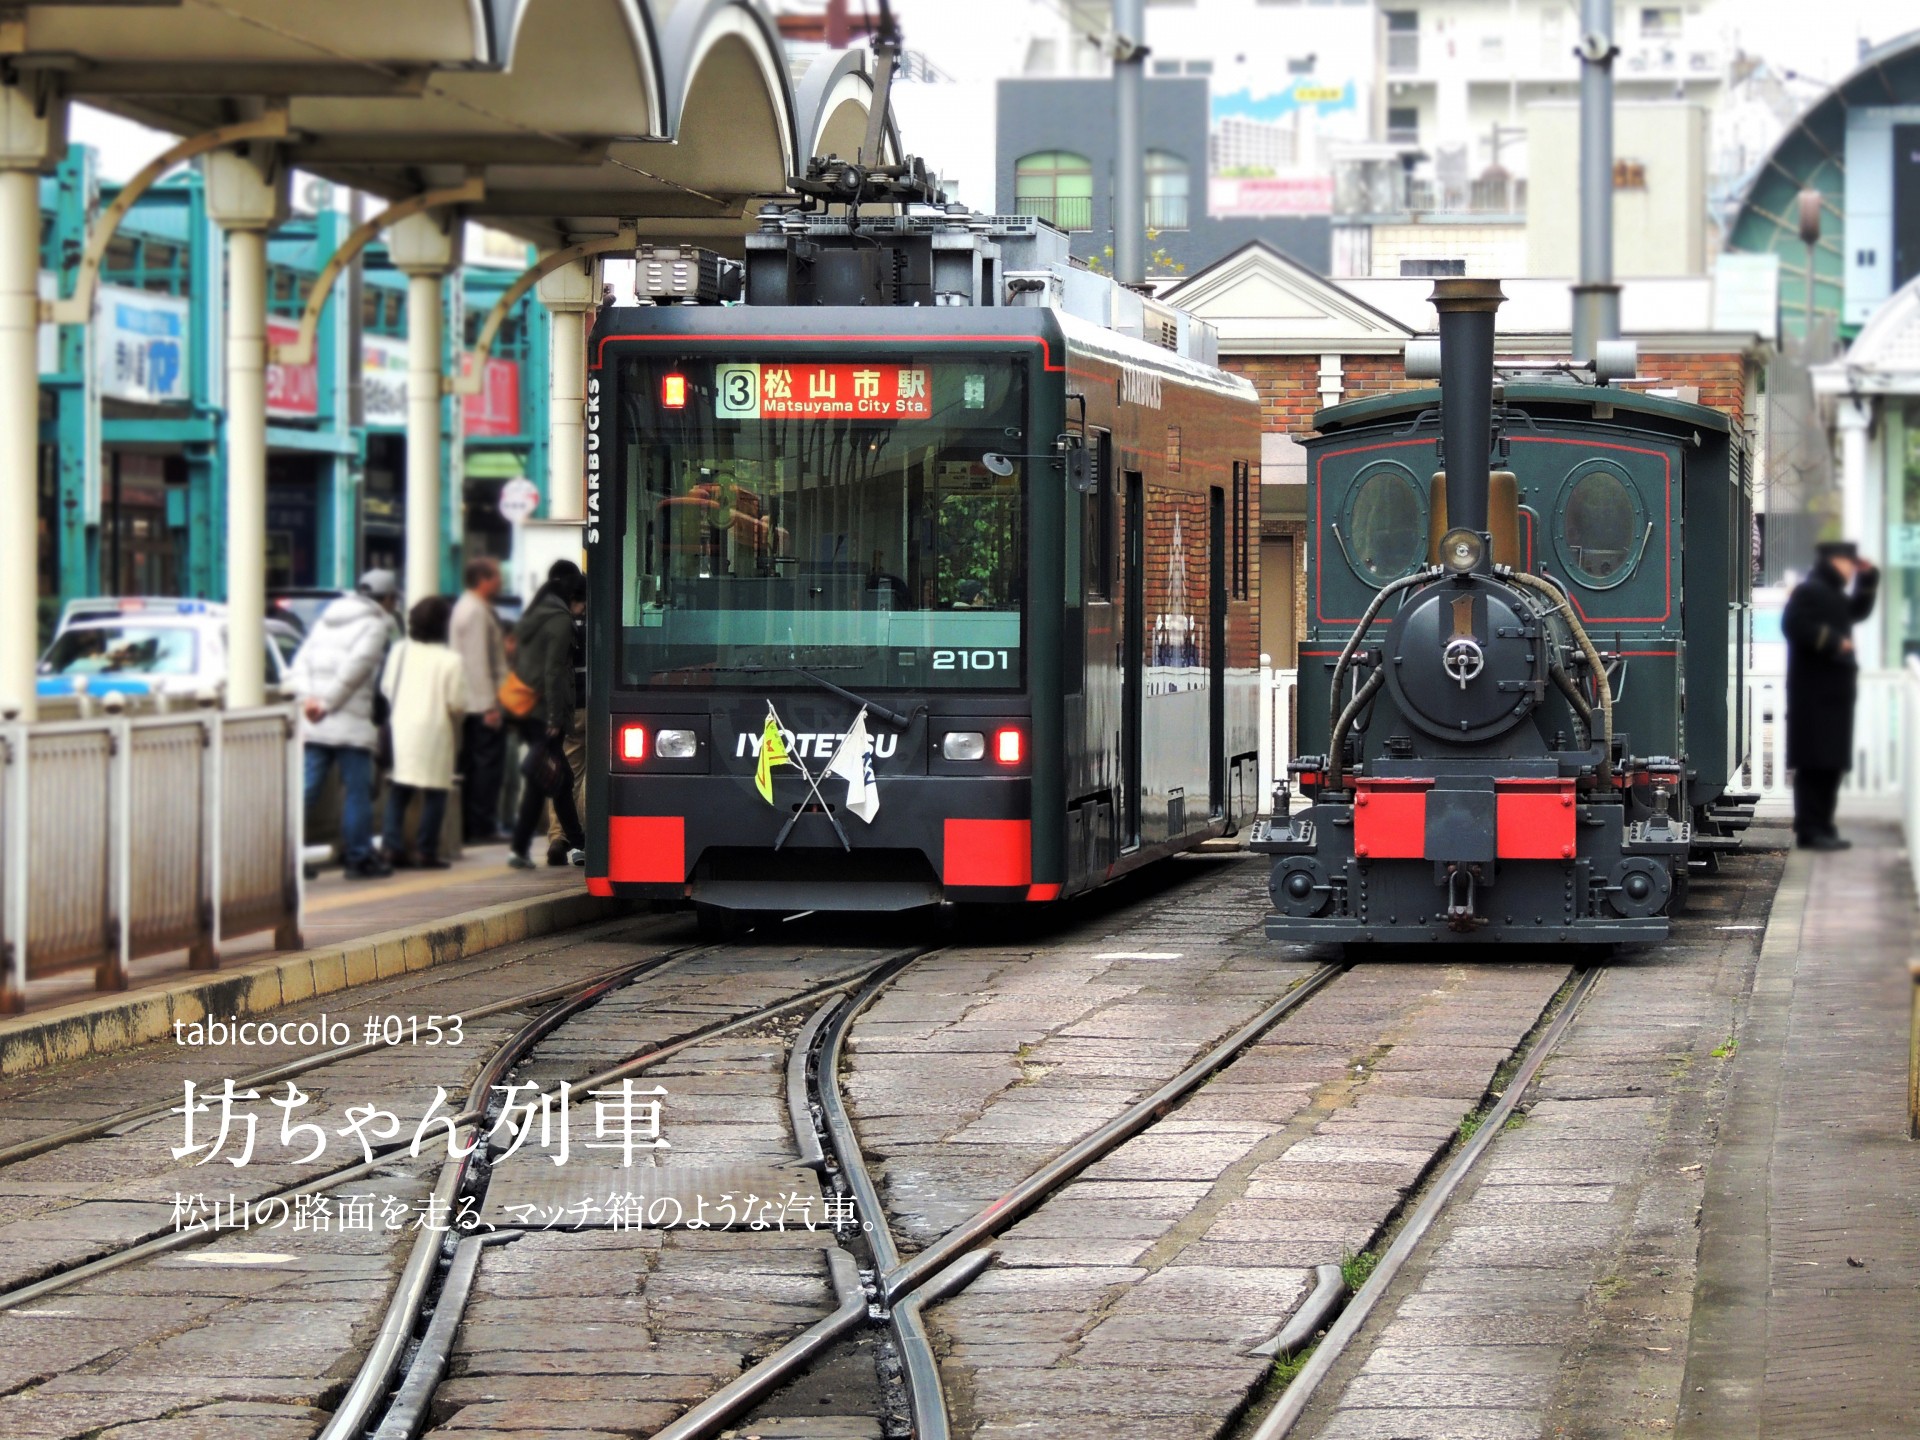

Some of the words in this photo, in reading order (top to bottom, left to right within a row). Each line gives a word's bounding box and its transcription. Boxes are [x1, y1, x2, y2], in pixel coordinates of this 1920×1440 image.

[728, 375, 750, 406] 3
[764, 369, 927, 399] 松山市駅
[764, 400, 853, 413] Matsuyama
[858, 400, 889, 413] City
[895, 400, 928, 413] Sta.
[588, 378, 600, 544] STARBUCKS
[932, 650, 1009, 670] 2101
